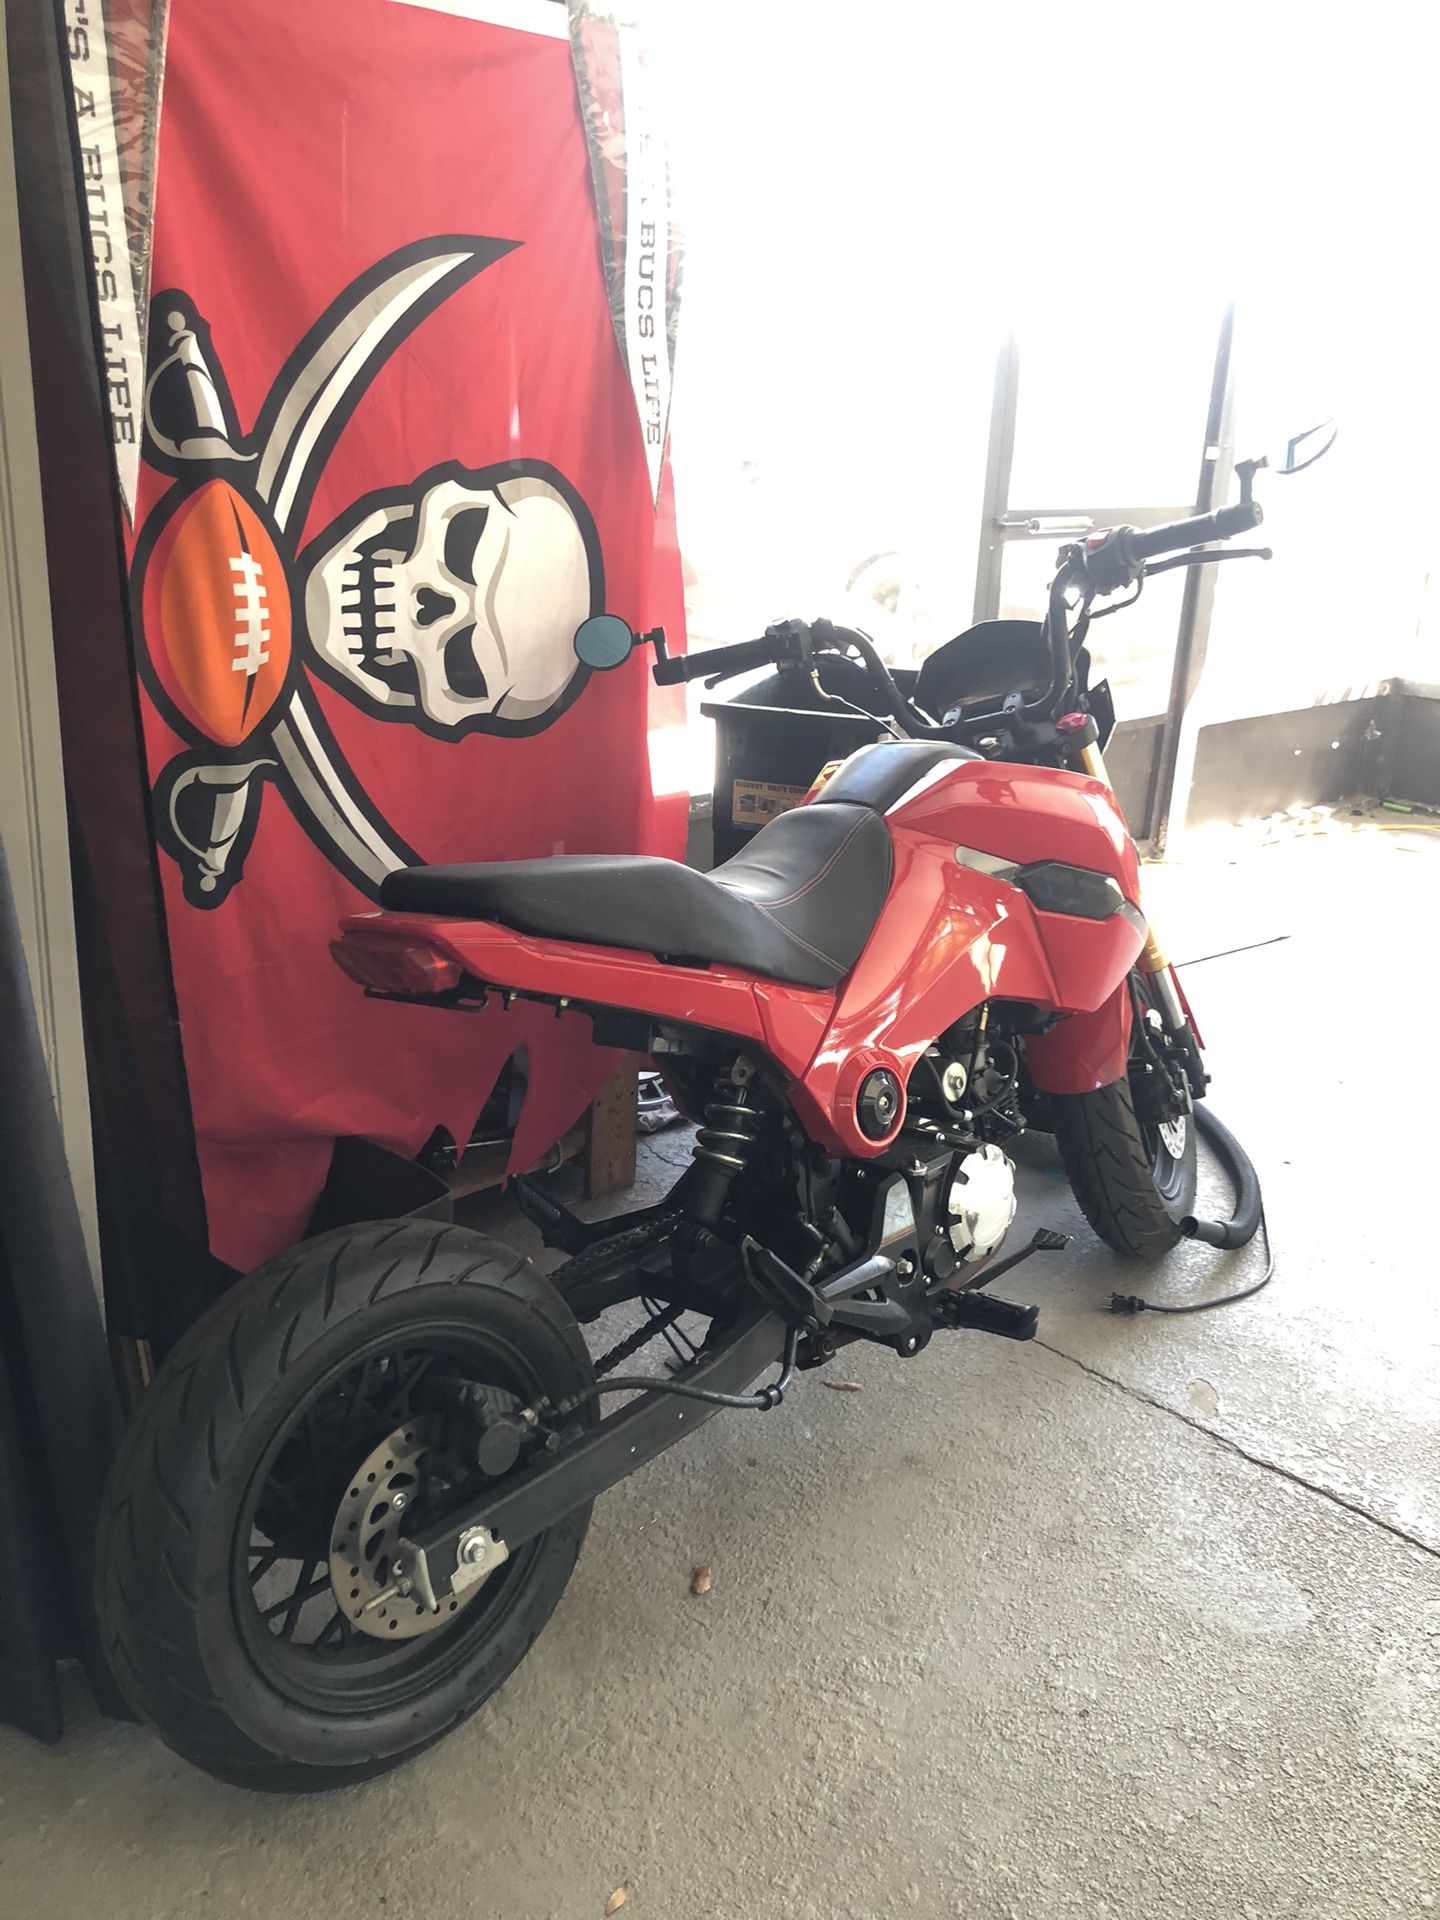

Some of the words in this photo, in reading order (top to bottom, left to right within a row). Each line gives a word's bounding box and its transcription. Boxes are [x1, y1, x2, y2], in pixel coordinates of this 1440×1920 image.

[73, 86, 96, 120] A
[80, 144, 117, 301] BUCS
[638, 220, 655, 340] BUCS
[102, 323, 135, 446] LIFE
[641, 353, 661, 446] LIFE
